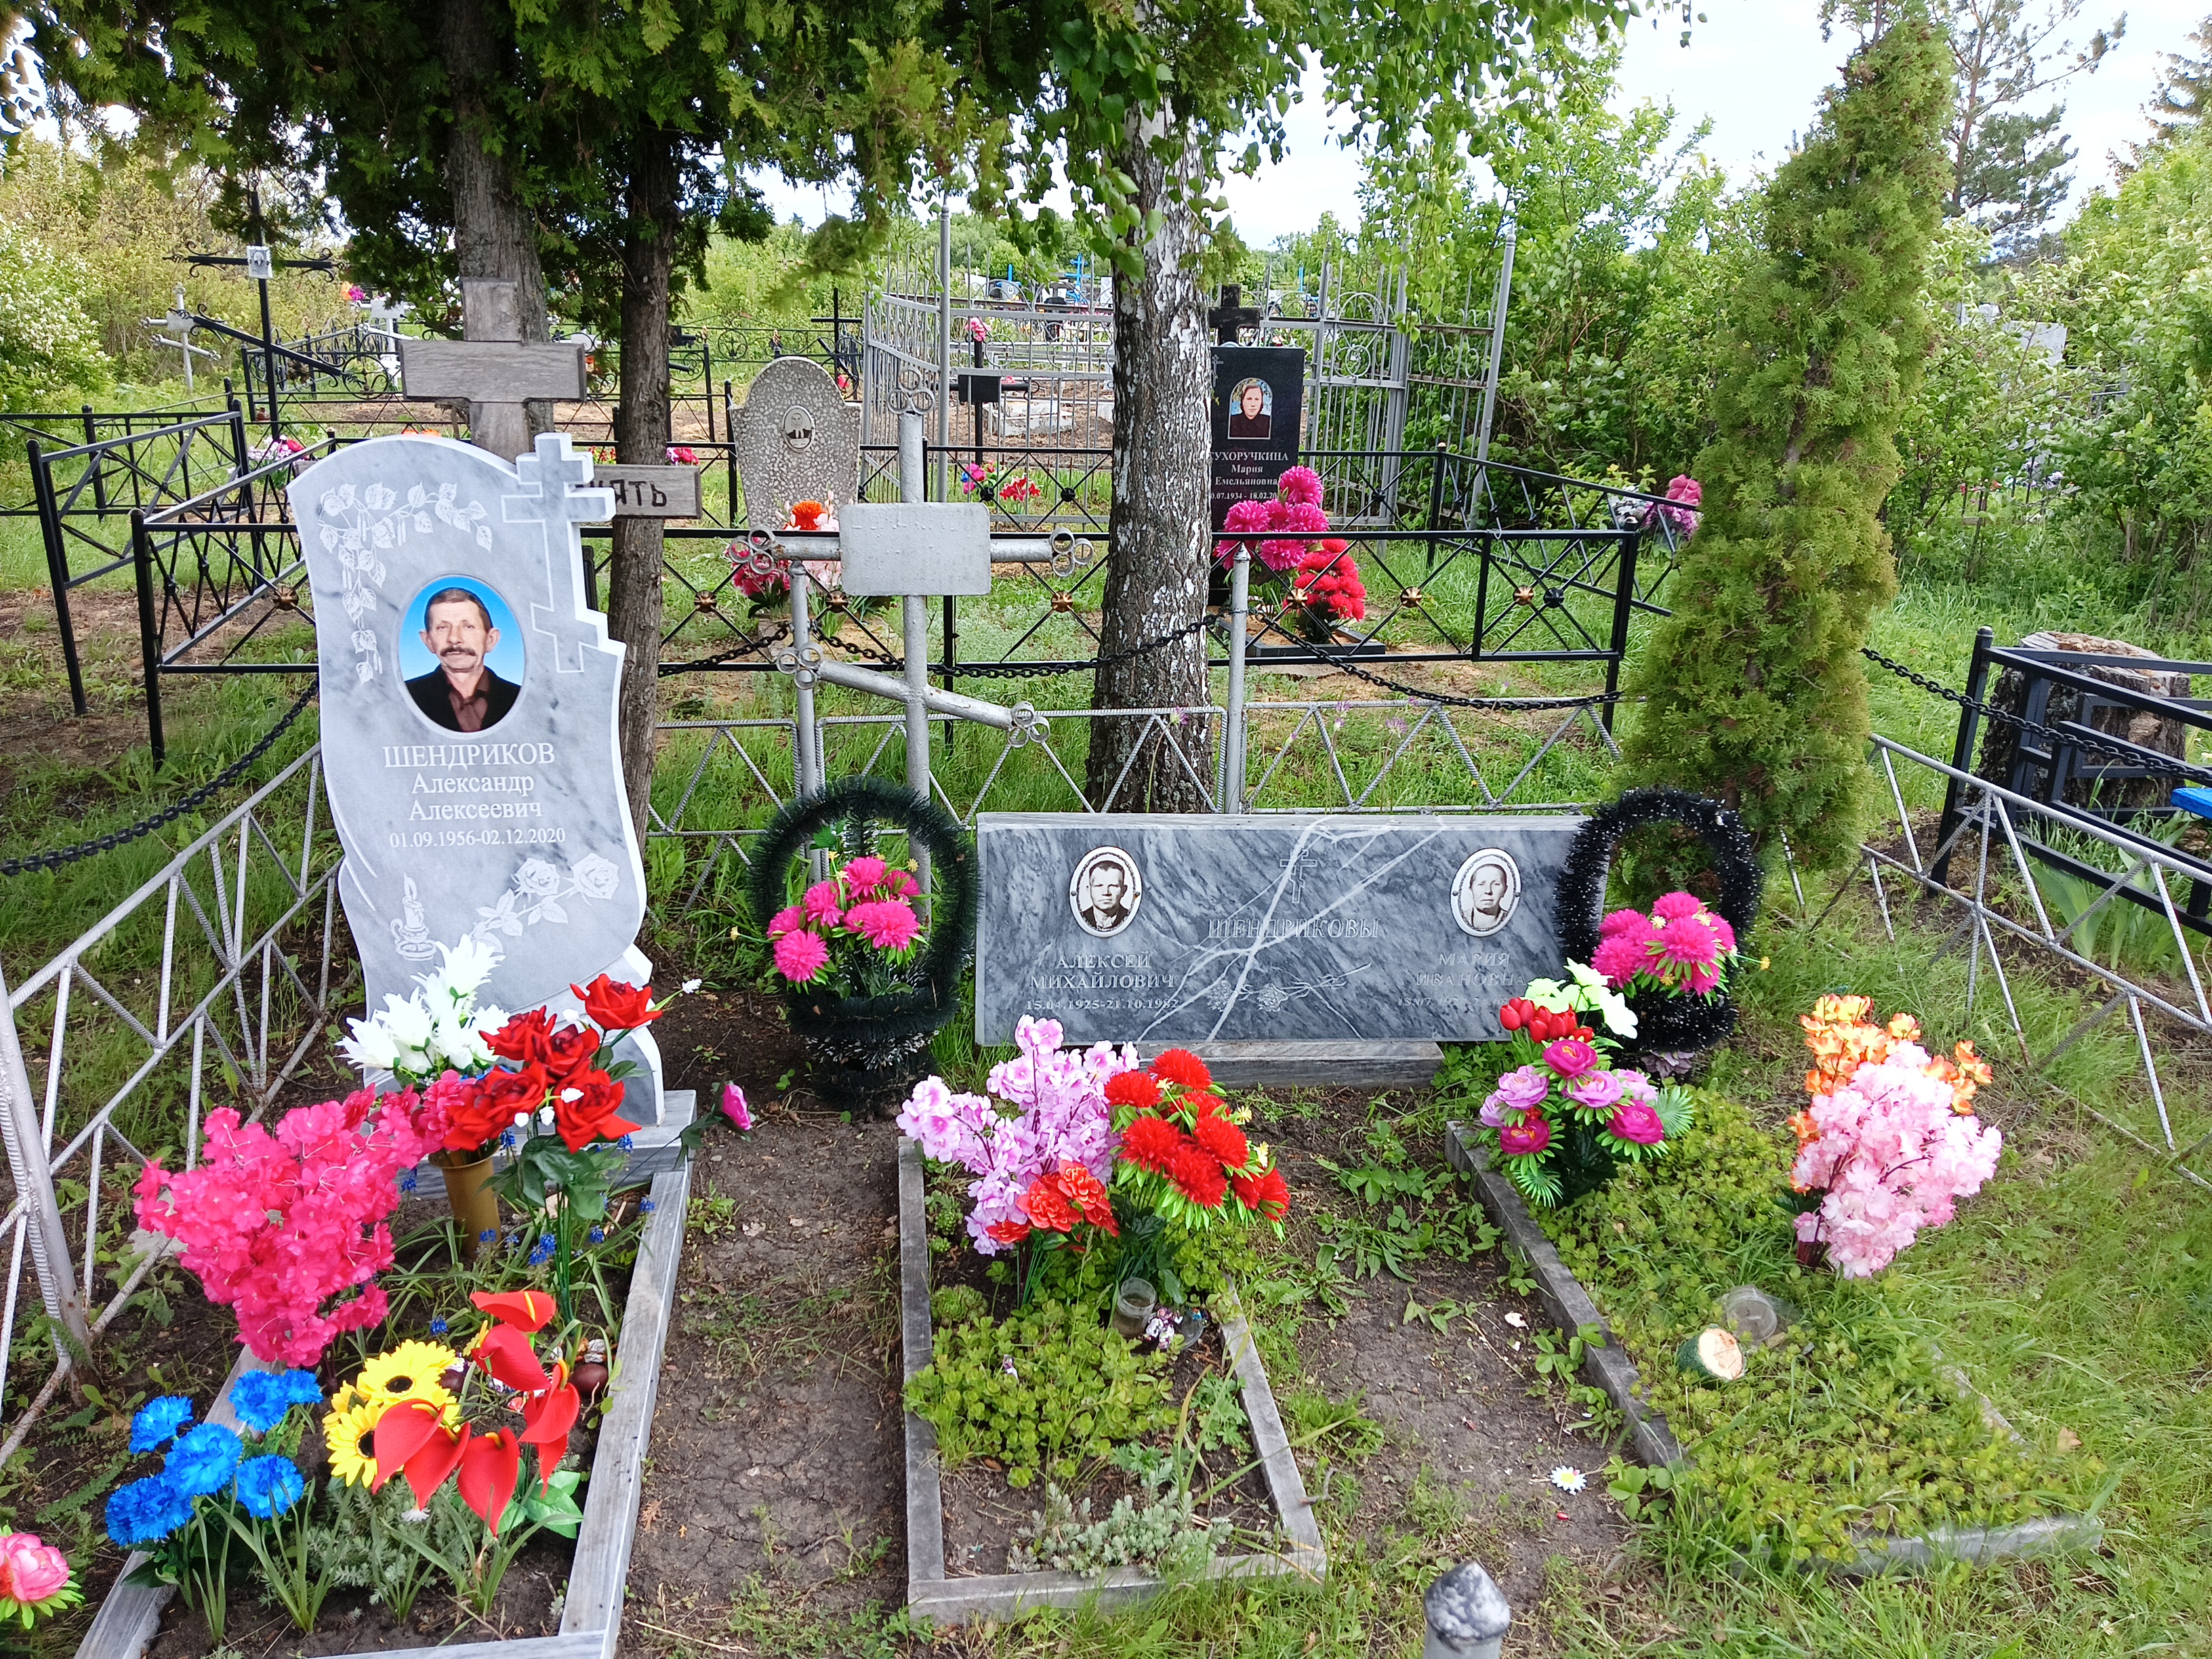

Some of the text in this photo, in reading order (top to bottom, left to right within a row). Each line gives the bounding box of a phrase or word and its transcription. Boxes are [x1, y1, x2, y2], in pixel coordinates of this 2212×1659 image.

[1231, 464, 1263, 475] Мария
[1214, 476, 1277, 486] Емельяновна
[1210, 492, 1242, 500] 0.07.1934
[382, 742, 556, 771] ШЕНДРИКОВ
[411, 773, 535, 797] Александр
[409, 800, 542, 821] Алексеевич
[389, 827, 566, 848] 01.09.1956-02.12.2020
[1208, 918, 1381, 940] ШЕНДРИКОВЫ
[1055, 951, 1152, 969] АЛЕКСЕЙ
[1439, 952, 1511, 966] МАРИЯ
[1029, 971, 1176, 989] МИХАЙЛОВИЧ
[1416, 972, 1528, 986] ИВАНОВНА
